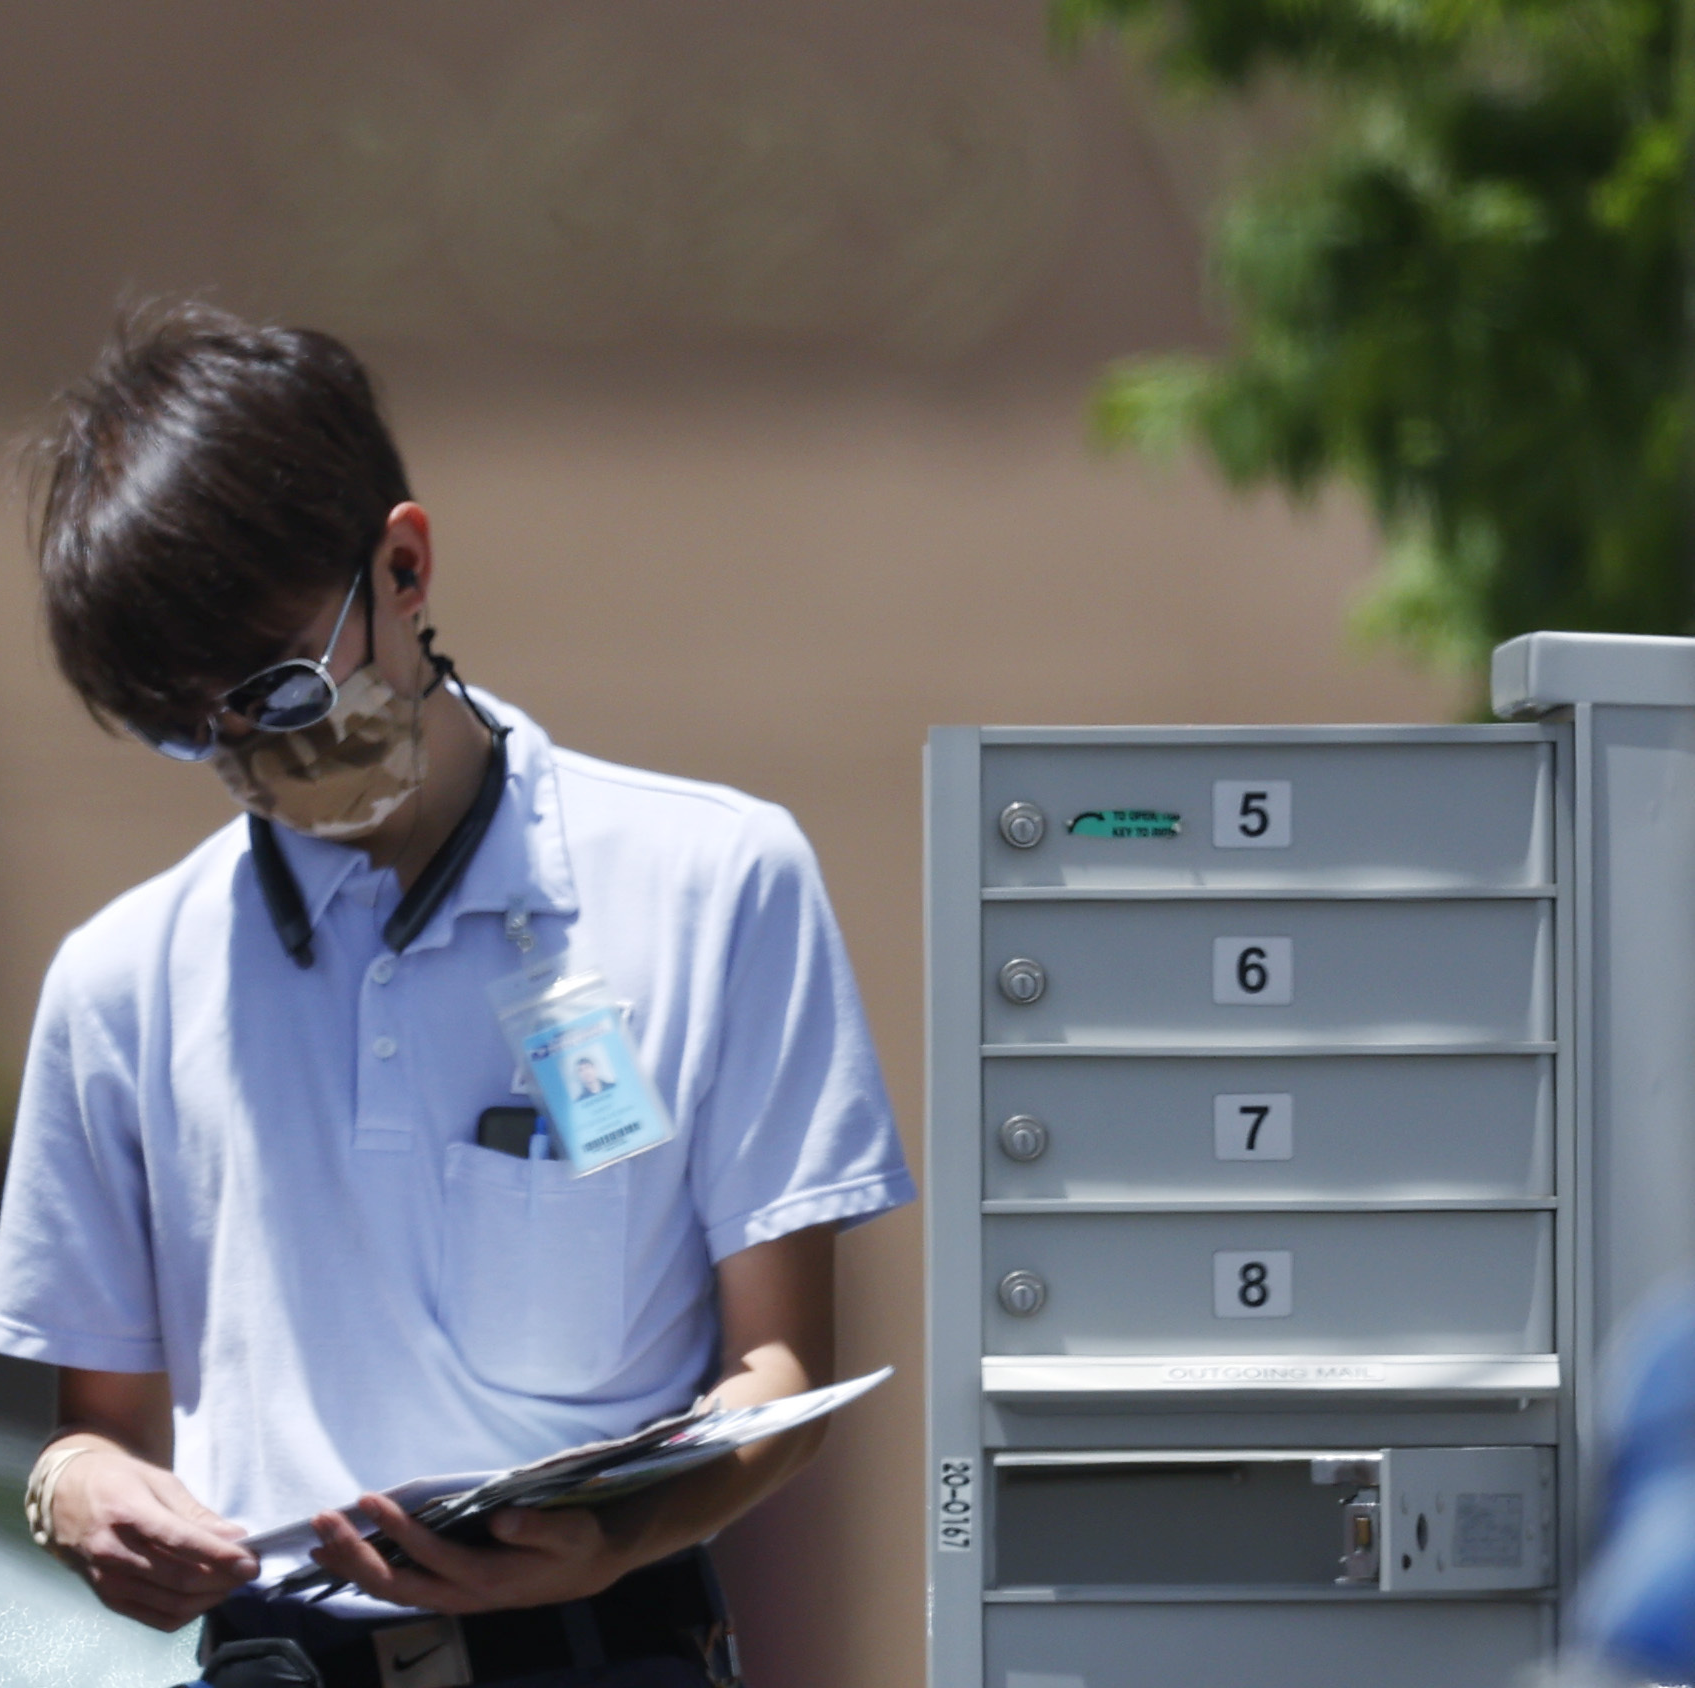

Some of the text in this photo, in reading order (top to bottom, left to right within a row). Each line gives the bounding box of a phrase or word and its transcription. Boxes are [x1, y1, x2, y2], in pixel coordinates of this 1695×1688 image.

[1238, 791, 1270, 839] 5
[1236, 945, 1268, 995] 6
[1238, 1105, 1270, 1151] 7
[1237, 1261, 1270, 1309] 8
[1168, 1366, 1373, 1380] OUTGOING MAIL
[941, 1461, 971, 1549] 20-0167
